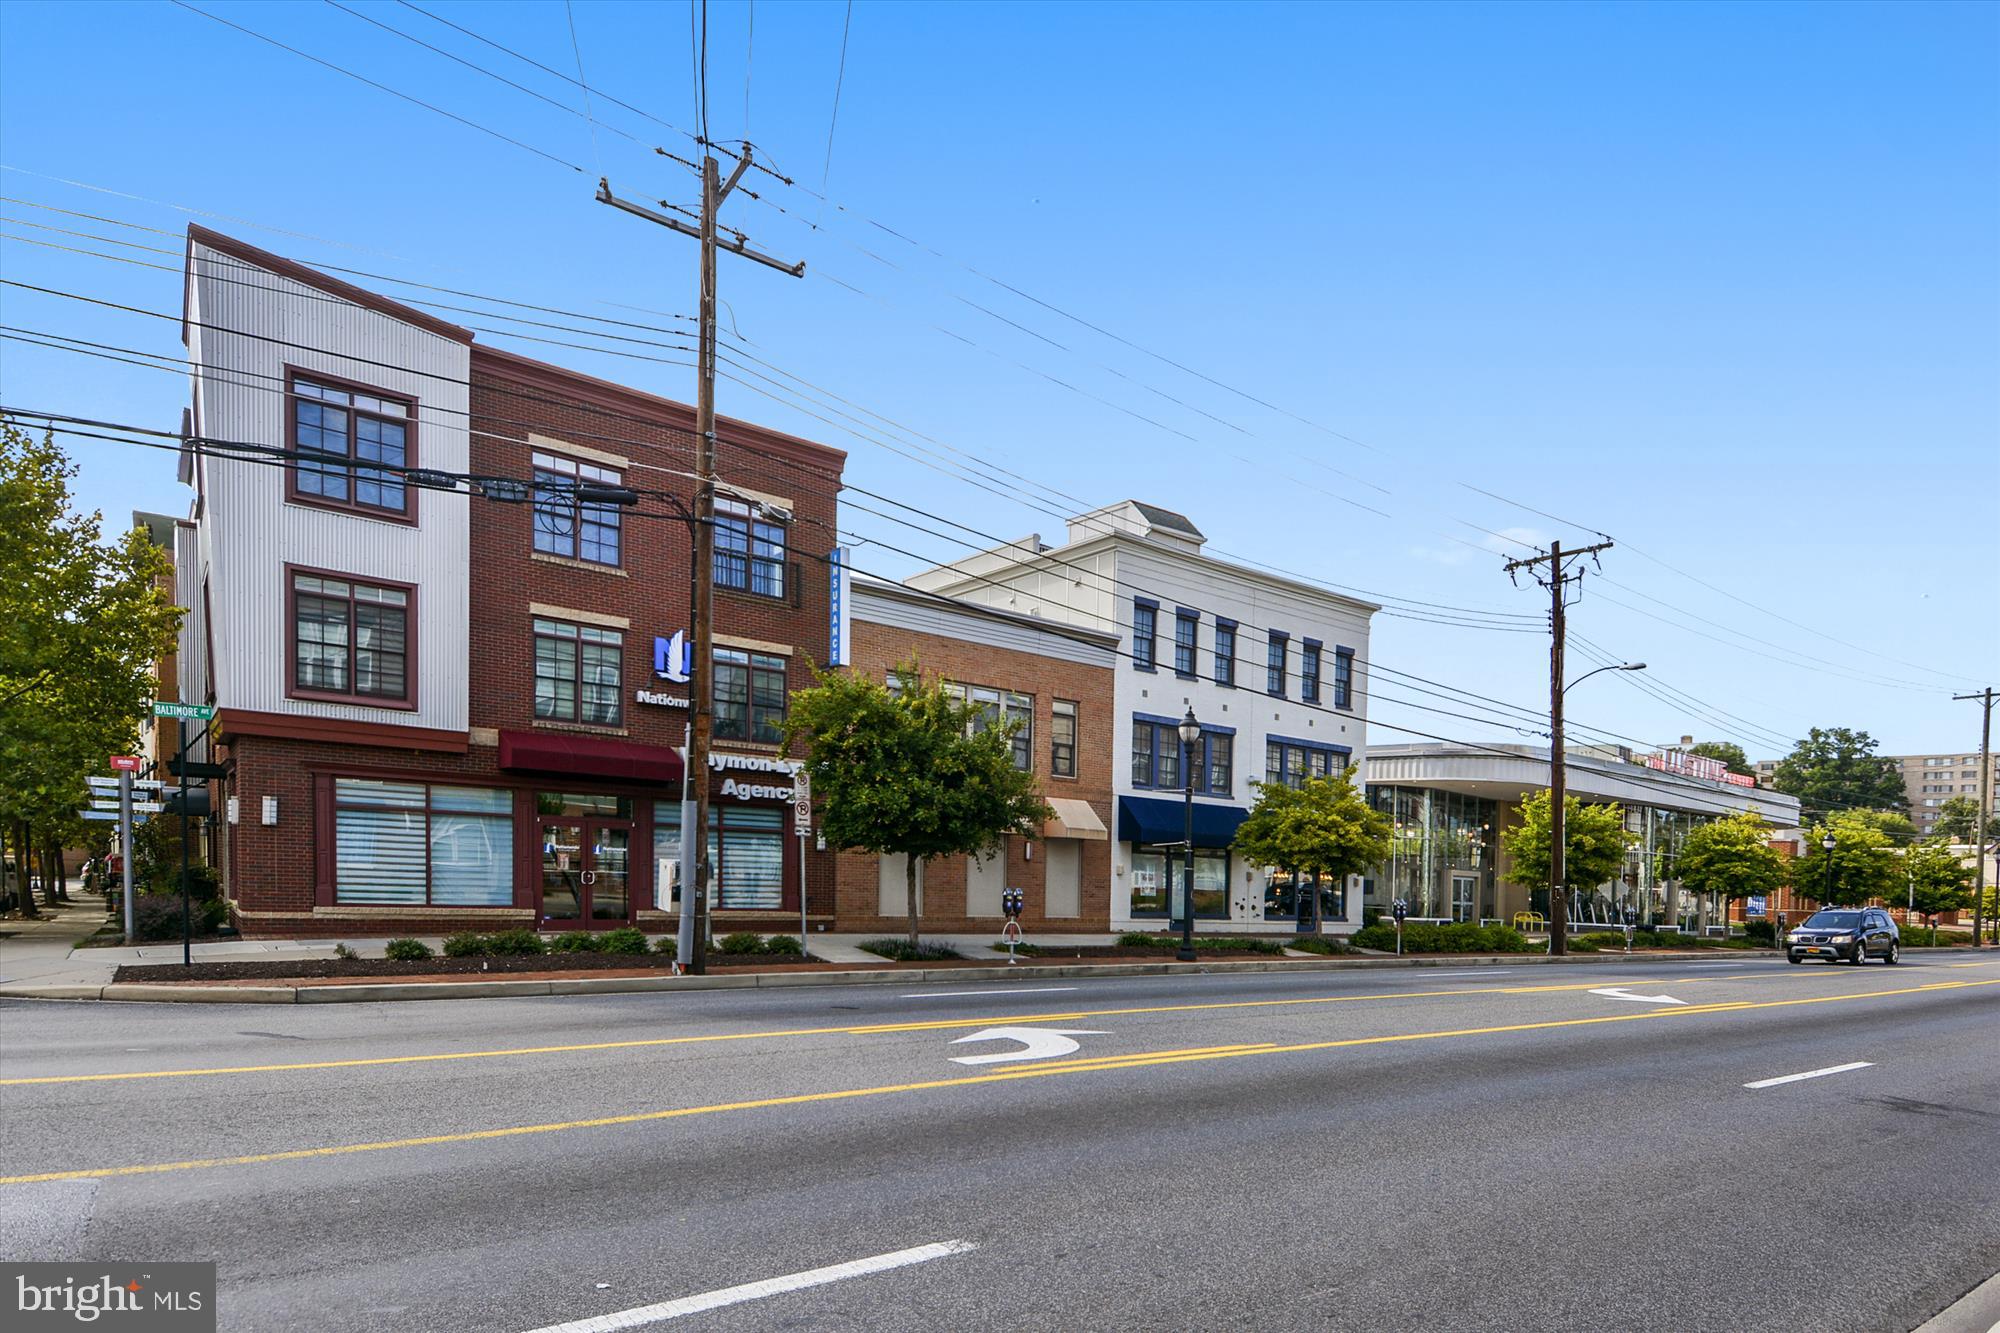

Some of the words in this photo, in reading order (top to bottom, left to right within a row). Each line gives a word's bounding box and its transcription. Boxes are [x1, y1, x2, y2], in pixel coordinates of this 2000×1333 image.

[636, 690, 690, 708] Nationw
[155, 704, 198, 717] BALTIMORE
[720, 778, 795, 804] Agency
